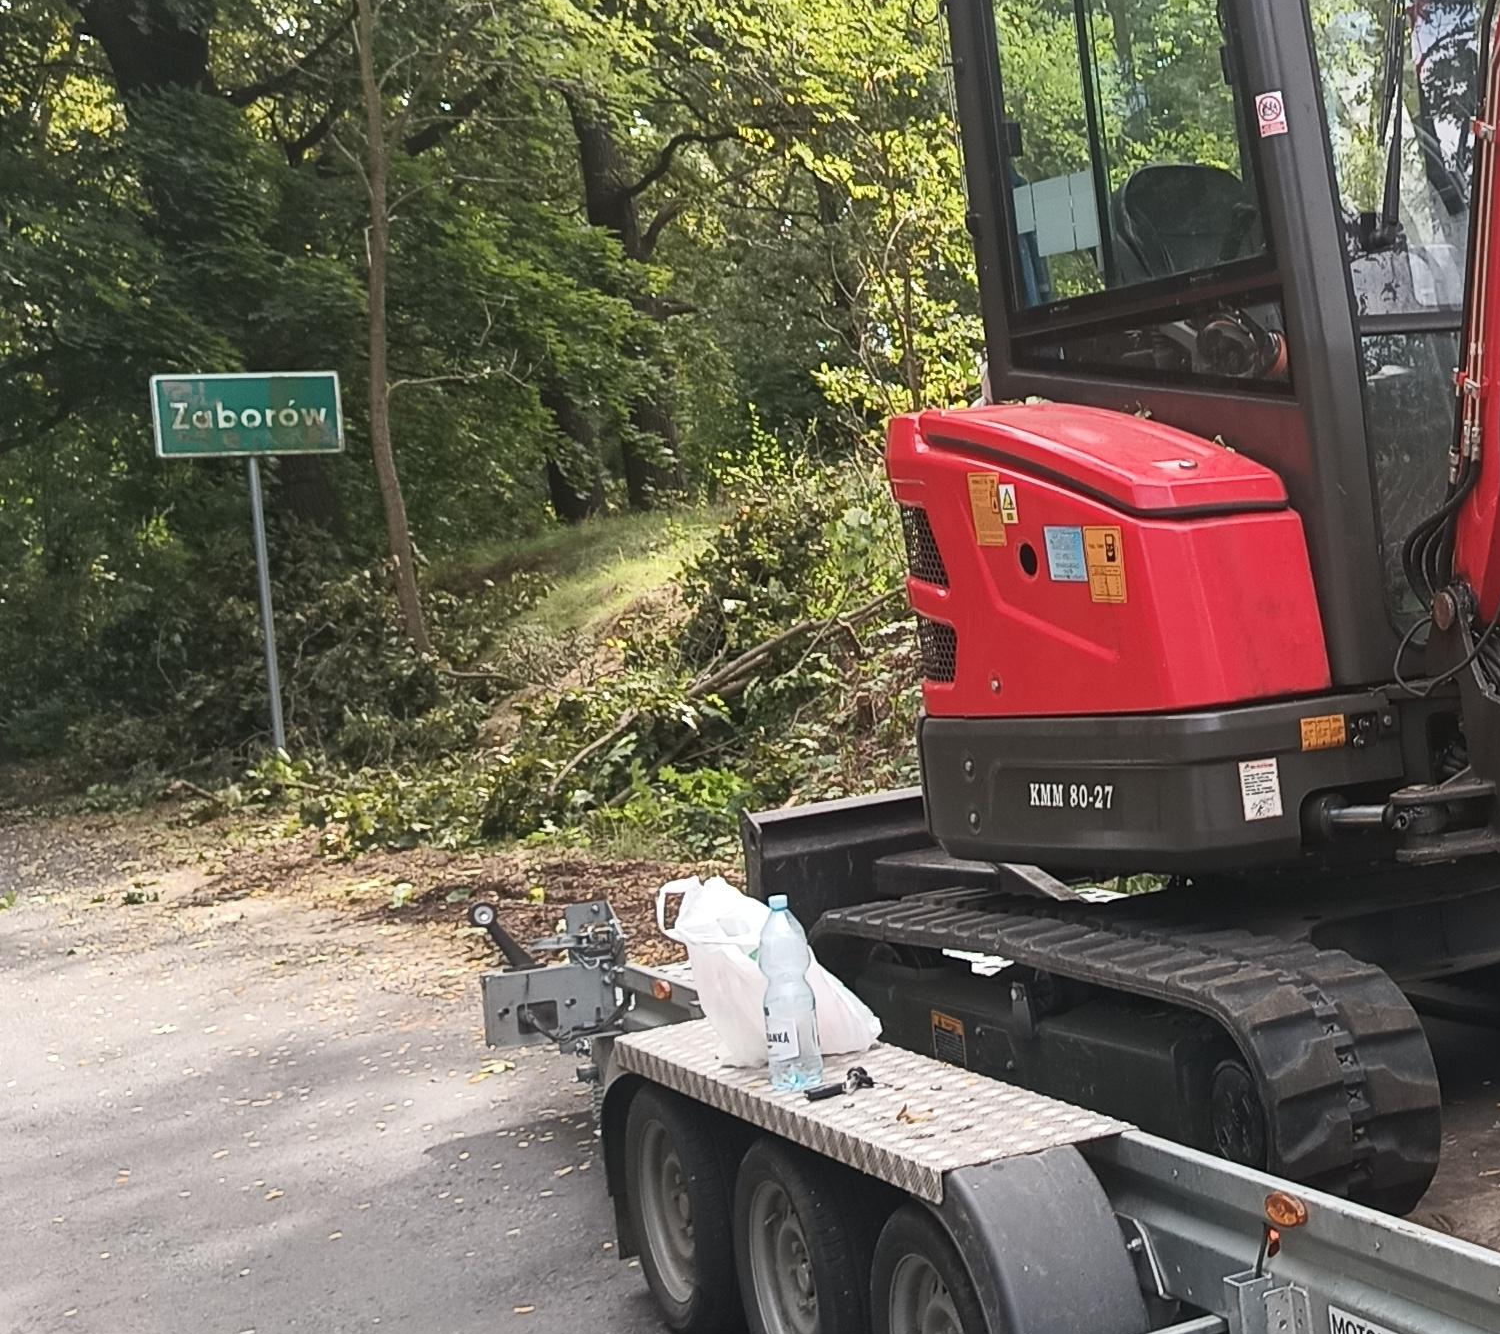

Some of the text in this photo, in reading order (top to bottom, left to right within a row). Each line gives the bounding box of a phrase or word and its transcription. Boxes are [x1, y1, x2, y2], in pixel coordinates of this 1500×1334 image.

[170, 399, 327, 430] Zaborów
[1029, 783, 1113, 809] KMM 80-27
